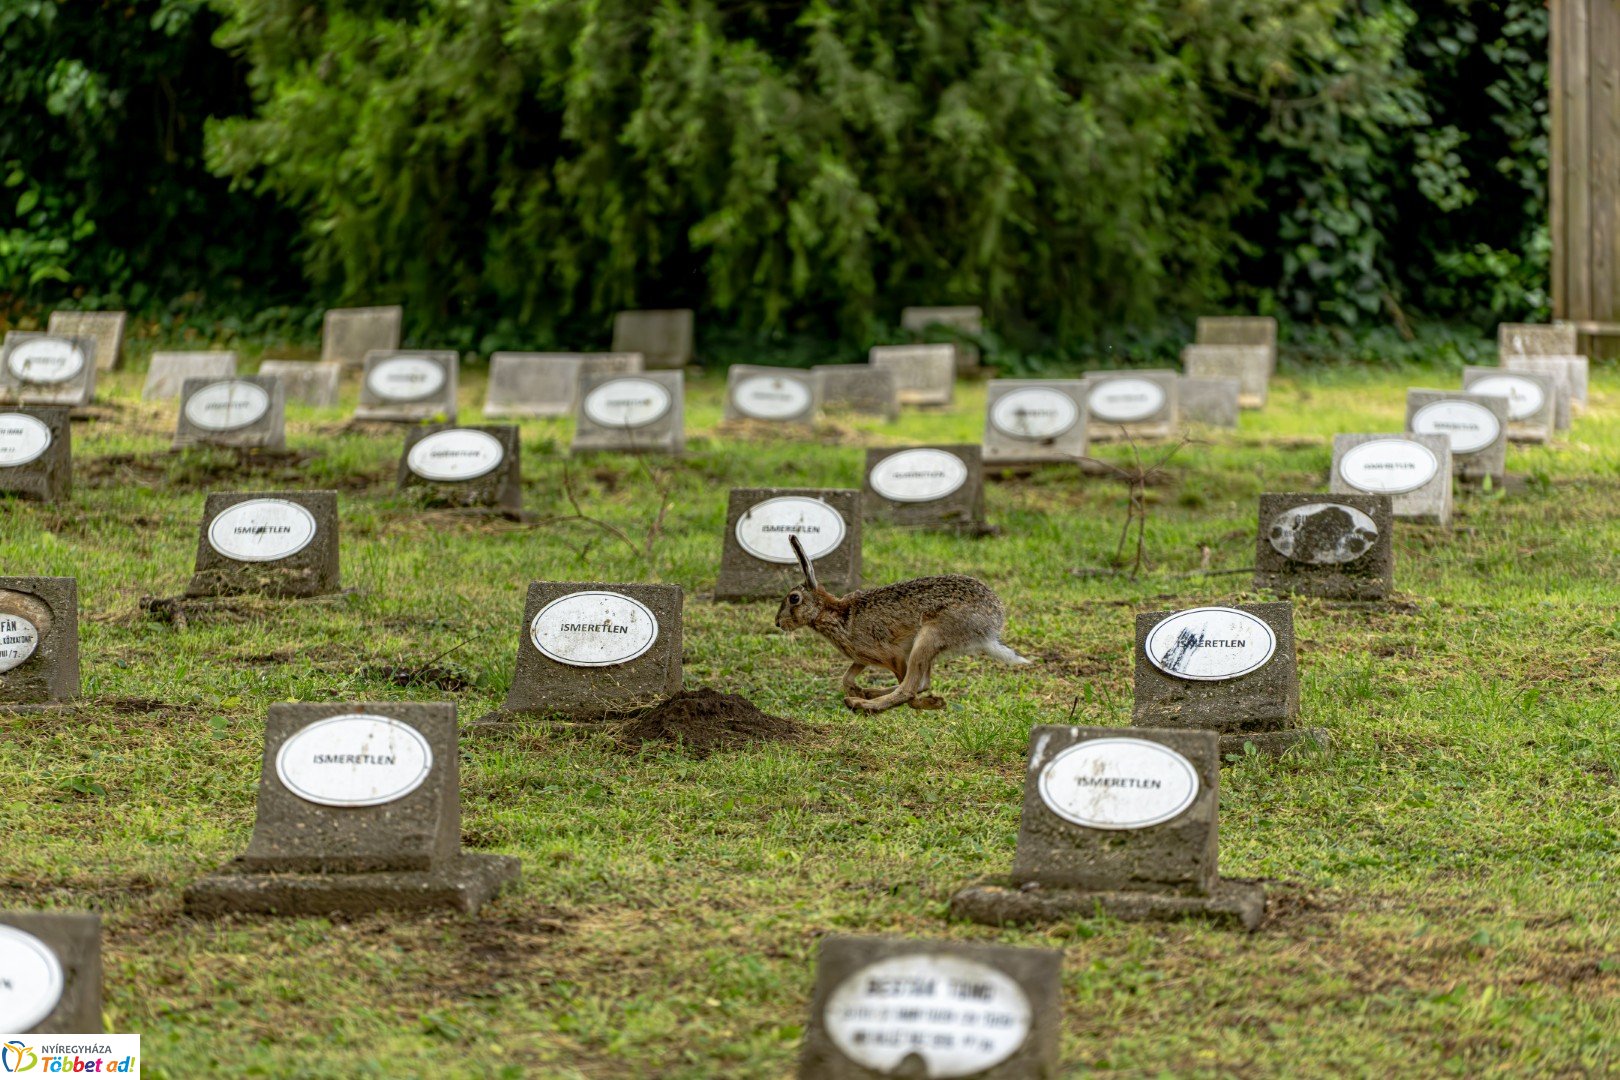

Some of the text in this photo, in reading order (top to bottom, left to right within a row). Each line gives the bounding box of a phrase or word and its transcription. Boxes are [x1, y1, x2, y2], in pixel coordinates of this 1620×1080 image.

[762, 524, 820, 533] ISMERETLEN
[560, 623, 628, 634] ISMERETLEN
[313, 754, 396, 765] ISMERETLEN
[1077, 777, 1162, 789] ISMERETLEN
